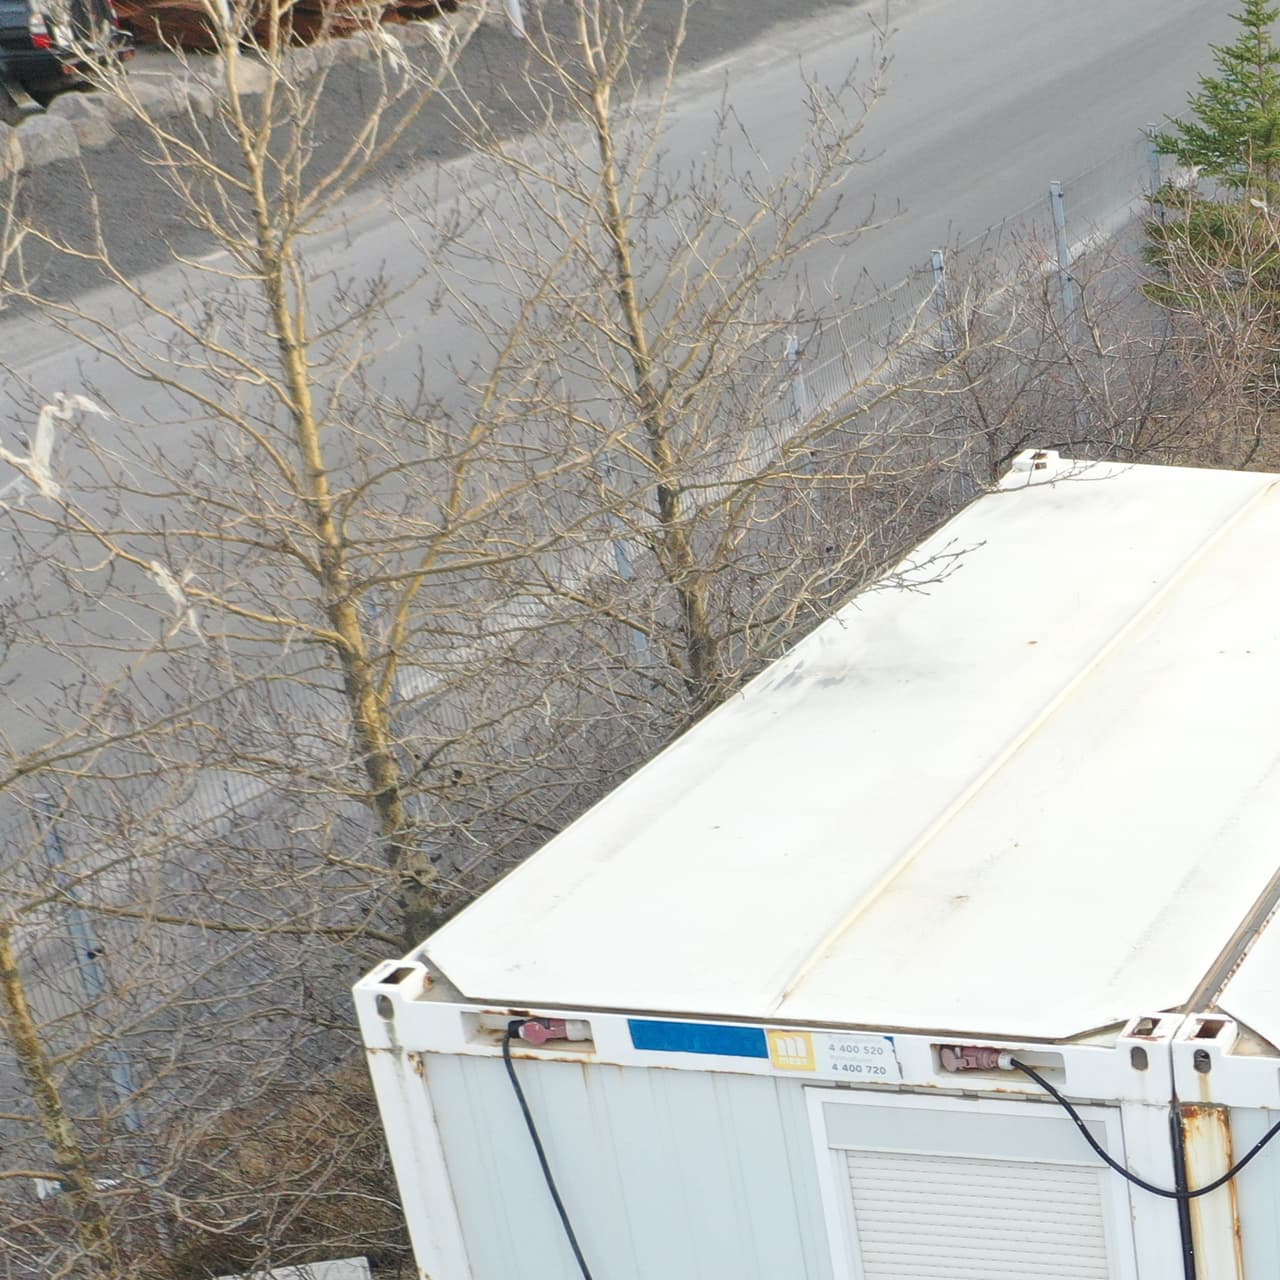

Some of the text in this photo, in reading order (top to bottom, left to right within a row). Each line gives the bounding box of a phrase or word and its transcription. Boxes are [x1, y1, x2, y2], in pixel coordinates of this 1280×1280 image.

[839, 1044, 860, 1054] 400
[863, 1046, 884, 1055] 520
[842, 1064, 862, 1073] 400
[865, 1065, 887, 1075] 720
